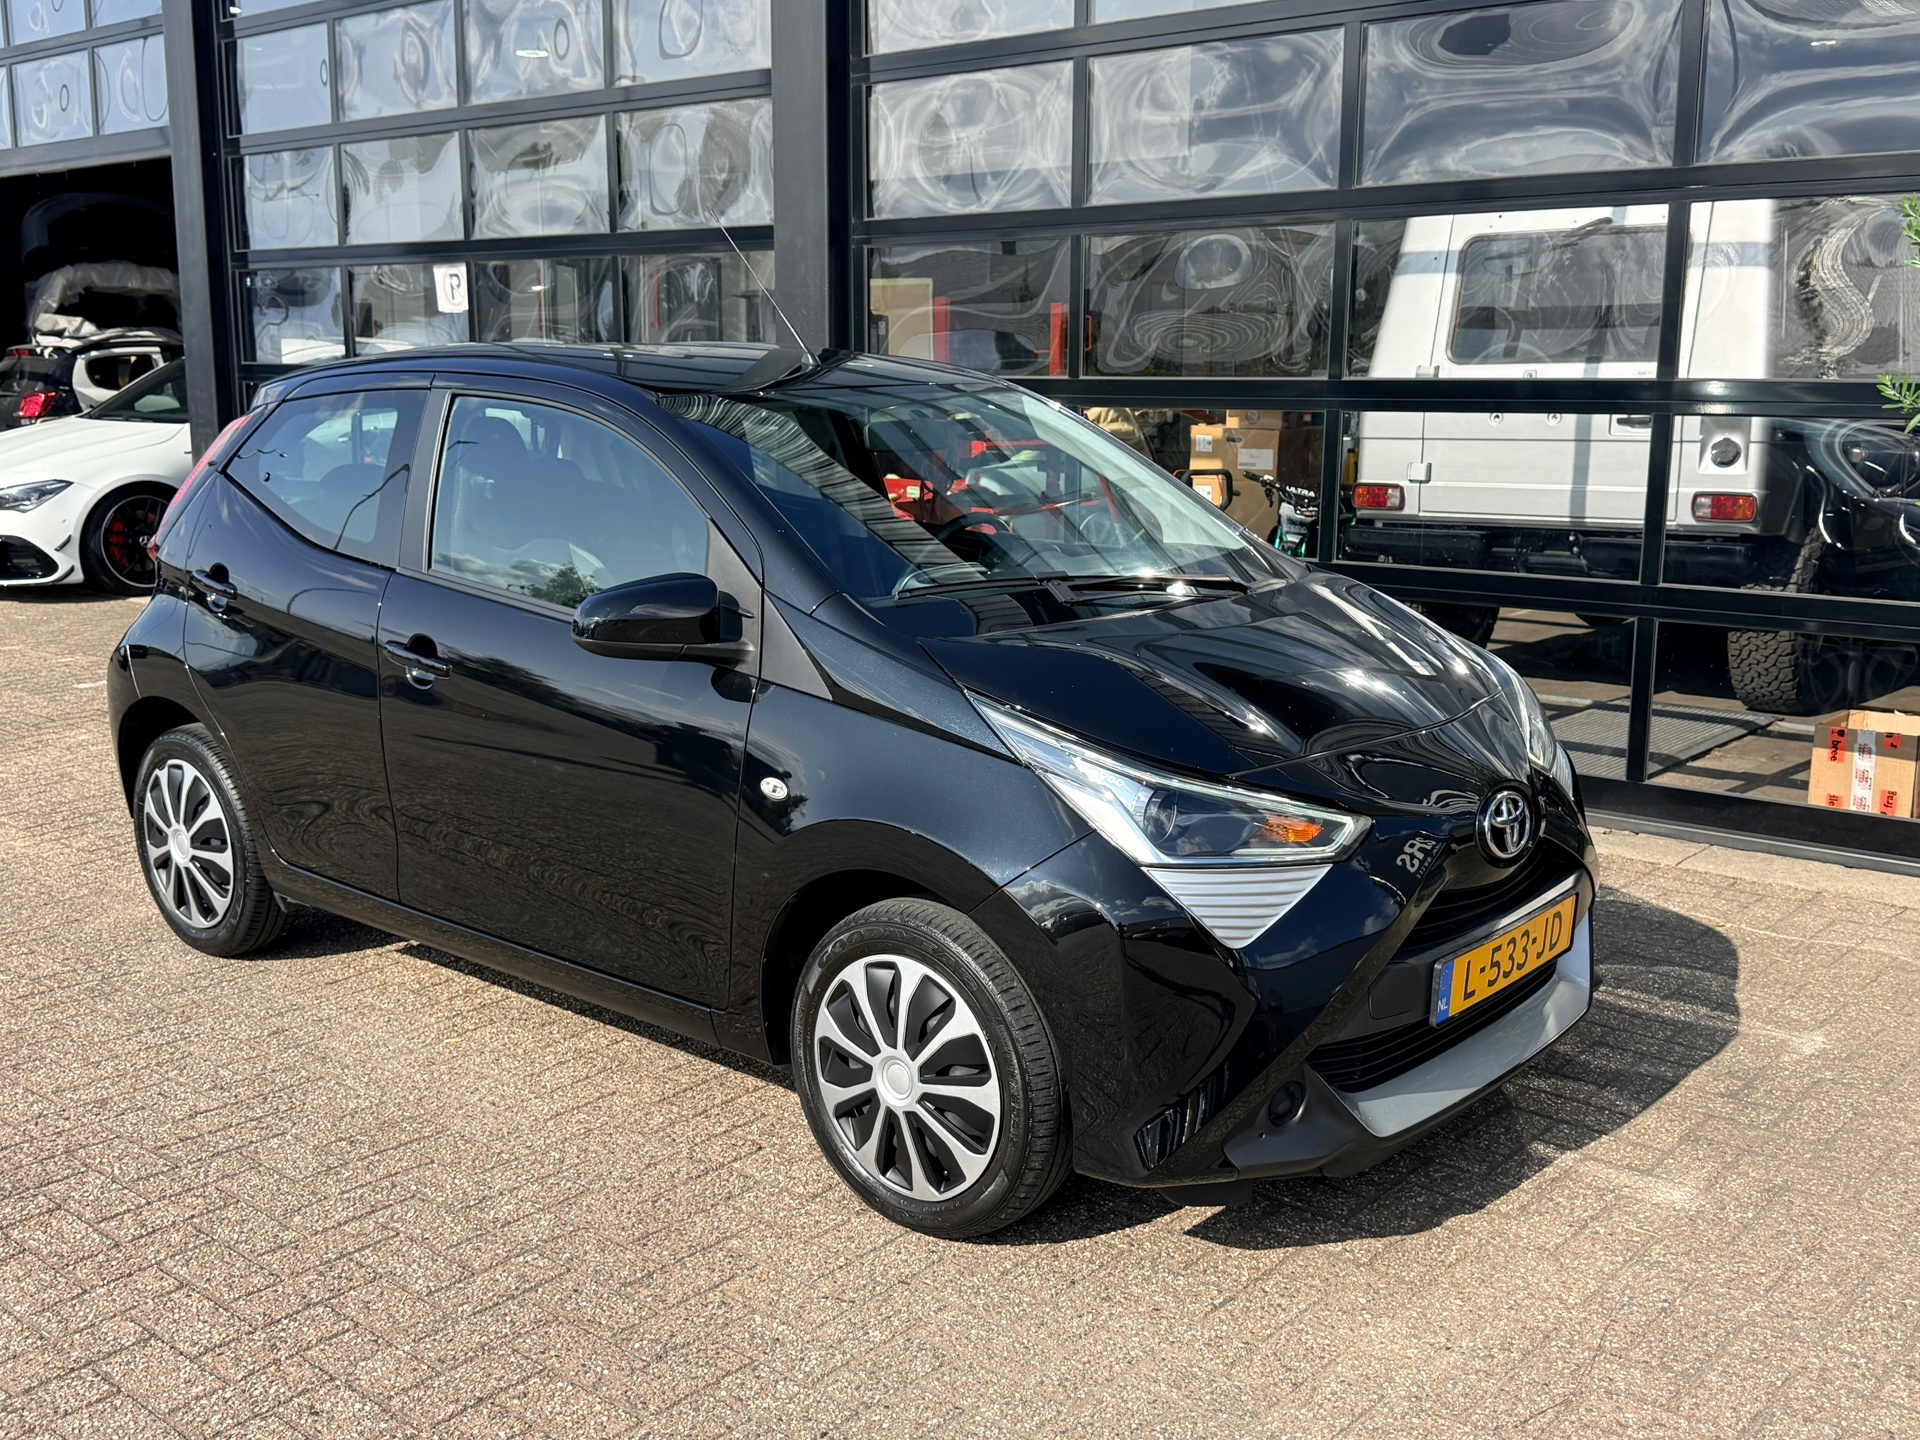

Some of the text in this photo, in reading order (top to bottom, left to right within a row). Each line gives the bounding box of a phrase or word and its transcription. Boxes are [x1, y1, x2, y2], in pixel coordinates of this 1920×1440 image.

[449, 273, 461, 300] P
[1285, 485, 1316, 498] ULTRA
[1830, 739, 1842, 762] bree
[1827, 793, 1839, 807] ile
[1463, 910, 1563, 1002] L-533-JD
[1437, 997, 1448, 1012] NL
